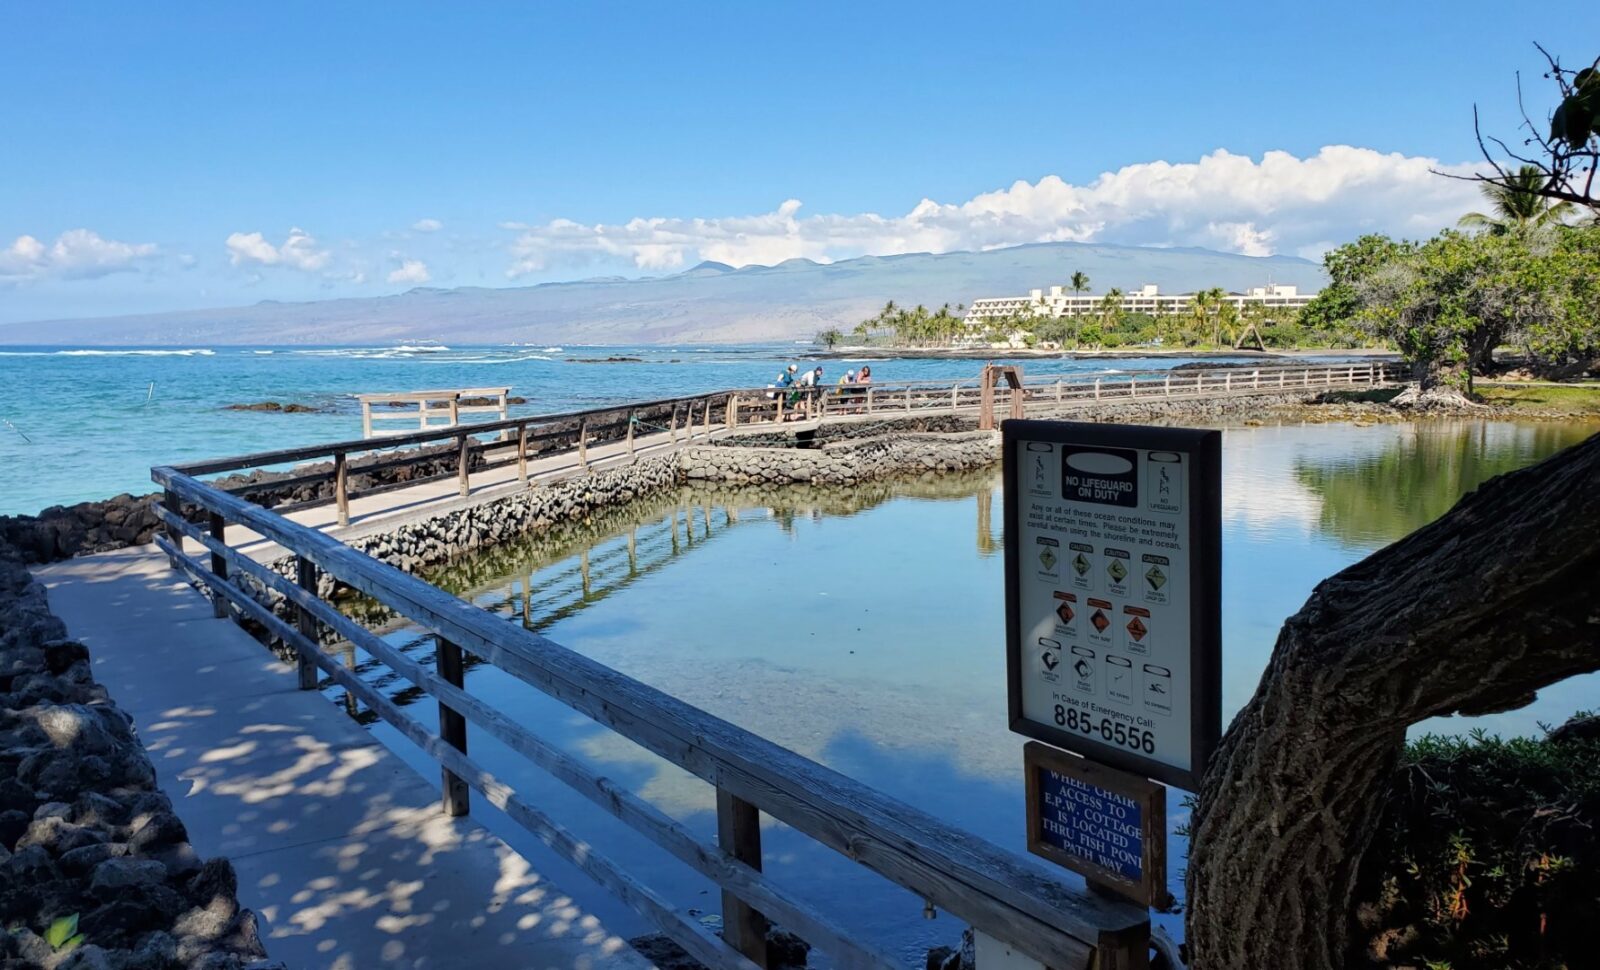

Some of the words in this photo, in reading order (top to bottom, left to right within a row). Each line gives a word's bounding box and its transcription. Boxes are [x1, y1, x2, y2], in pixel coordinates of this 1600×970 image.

[1065, 475, 1079, 487] NO
[1081, 477, 1134, 492] LIFEGUARD
[1078, 487, 1092, 498] ON
[1094, 489, 1120, 501] DUTY
[1032, 503, 1043, 513] Any
[1064, 507, 1071, 515] of
[1073, 508, 1092, 518] these
[1094, 512, 1116, 521] ocean
[1118, 515, 1156, 528] conditions
[1159, 521, 1175, 531] may
[1150, 503, 1179, 511] LIFEGUARD
[1027, 521, 1048, 530] careful
[1050, 523, 1067, 533] when
[1070, 527, 1088, 537] using
[1090, 529, 1101, 538] the
[1103, 532, 1136, 544] shoreline
[1138, 537, 1153, 546] and
[1155, 540, 1182, 551] ocean.
[1029, 512, 1044, 521] exist
[1046, 514, 1052, 522] at
[1054, 516, 1076, 525] certain
[1079, 518, 1098, 529] times.
[1103, 521, 1127, 533] Please
[1129, 525, 1139, 535] be
[1141, 529, 1179, 542] extremely
[1071, 543, 1093, 553] CAUTION
[1105, 549, 1129, 558] CAUTION
[1143, 555, 1169, 565] CAUTION
[1052, 691, 1060, 700] In
[1061, 694, 1079, 706] Case
[1081, 699, 1089, 709] of
[1091, 701, 1135, 725] Emergency
[1136, 717, 1156, 729] Call:
[1054, 704, 1155, 755] 885-6556
[1050, 770, 1090, 792] WHEEL
[1095, 786, 1136, 809] CHAIR
[1060, 786, 1102, 810] ACCESS
[1107, 802, 1126, 819] TO
[1044, 792, 1080, 816] E.P.W.
[1084, 808, 1142, 840] COTTAGE
[1058, 810, 1068, 824] IS
[1072, 817, 1129, 848] LOCATED
[1043, 818, 1075, 840] THRU
[1080, 833, 1105, 853] FISH
[1063, 840, 1093, 860] PATH
[1099, 854, 1123, 873] WAY
